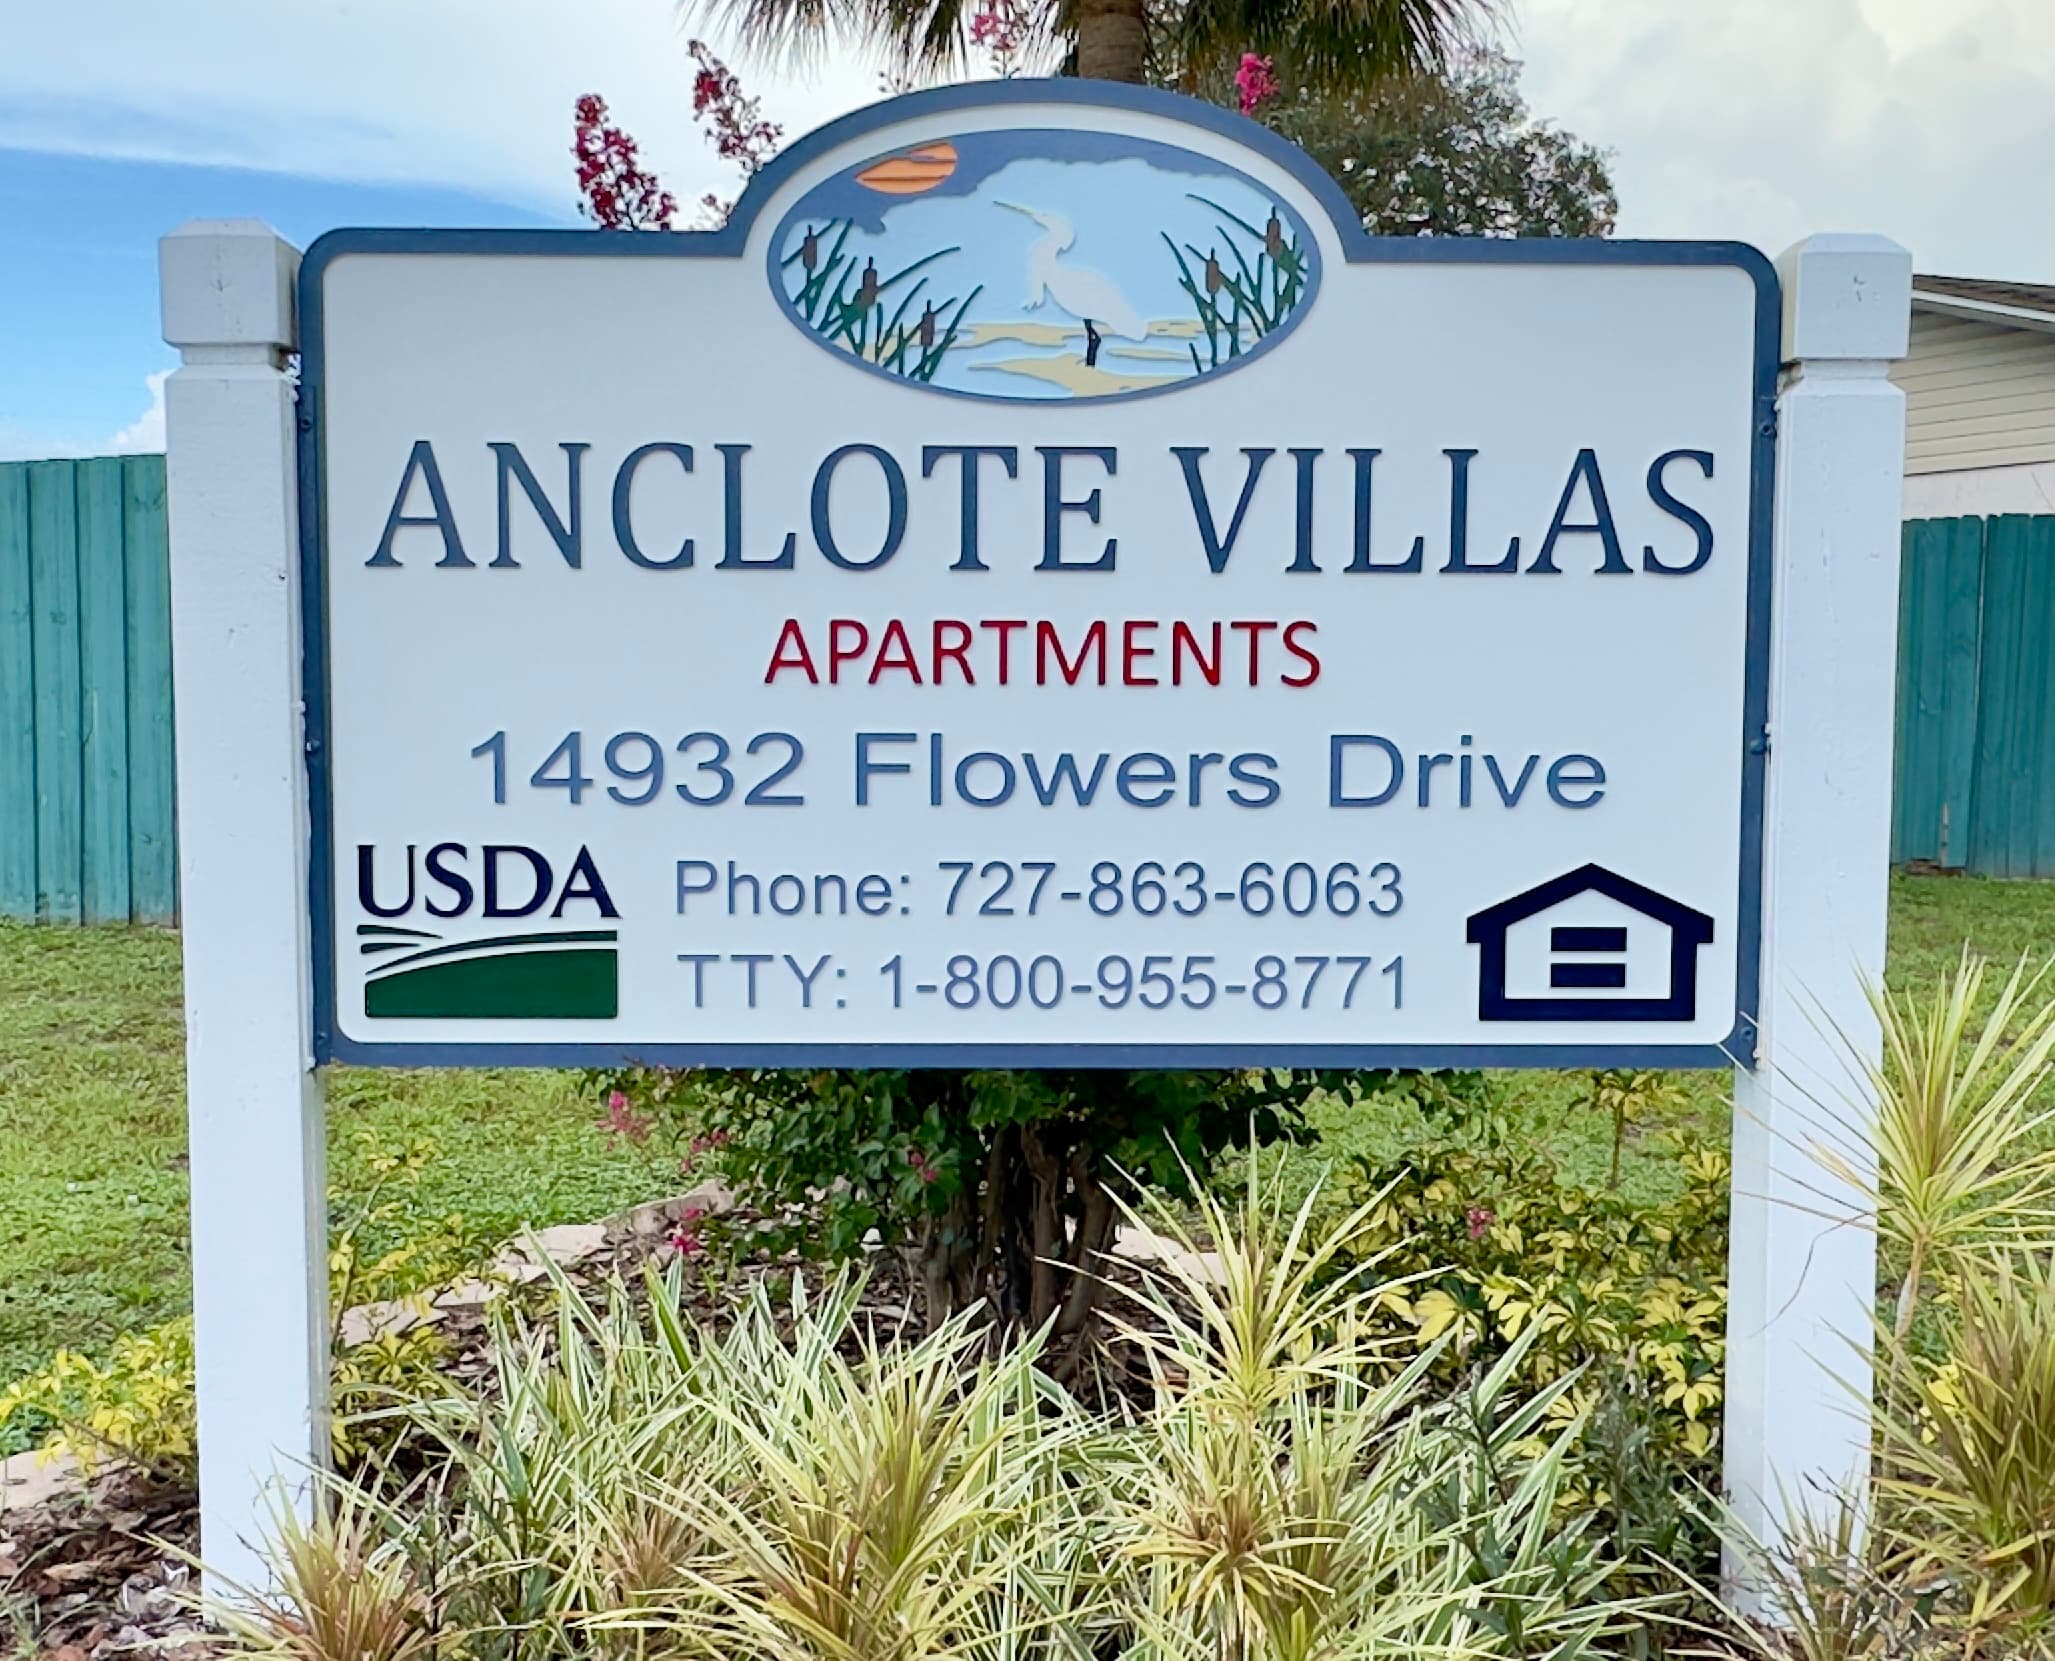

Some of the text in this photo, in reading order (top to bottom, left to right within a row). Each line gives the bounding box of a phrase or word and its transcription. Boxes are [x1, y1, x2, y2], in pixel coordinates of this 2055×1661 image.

[364, 440, 1714, 577] ANCLOTE VILLAS
[764, 619, 1321, 688] APARTMENTS
[471, 731, 1607, 810] 14932 Flowers Drive
[357, 843, 623, 919] USDA
[676, 860, 1403, 918] Phone: 727-863-6063
[677, 955, 1403, 1010] TTY: 1-800-955-8771
